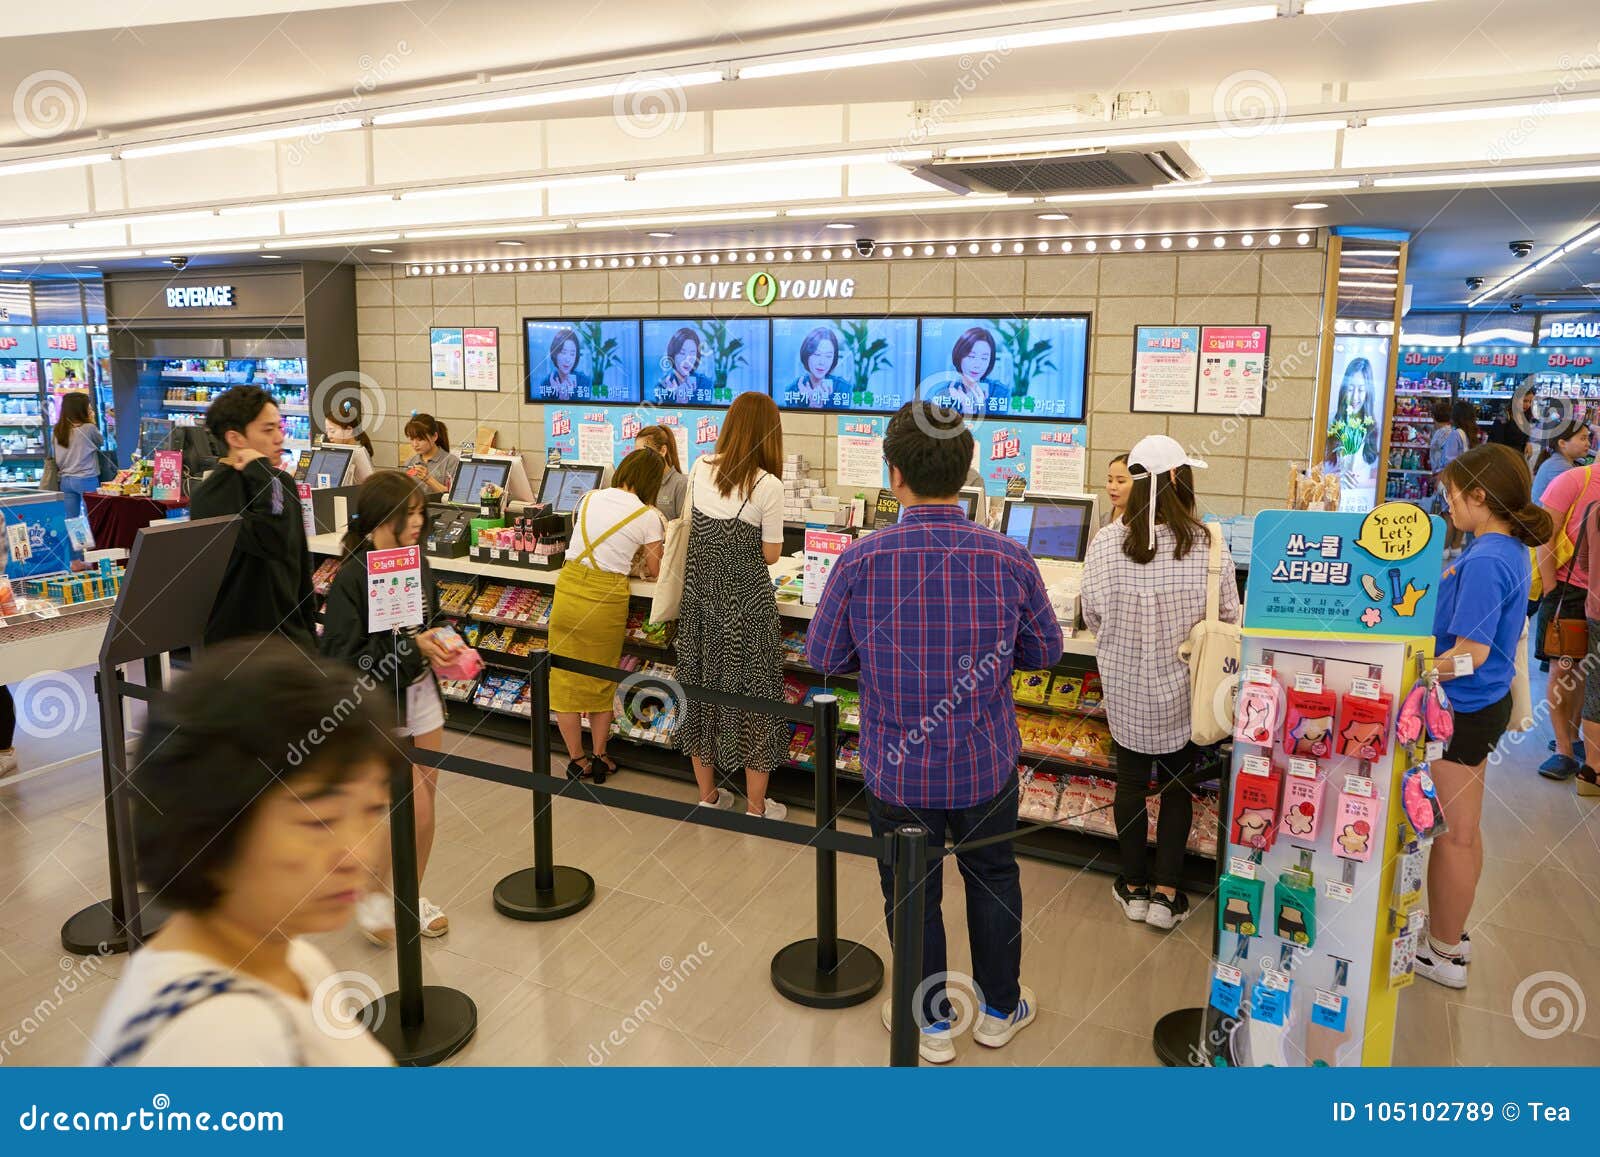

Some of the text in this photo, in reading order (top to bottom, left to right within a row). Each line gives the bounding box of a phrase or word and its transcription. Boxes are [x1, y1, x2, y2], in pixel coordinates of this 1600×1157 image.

[166, 285, 233, 308] BEVERAGE
[683, 281, 743, 300] OLIVE
[779, 278, 855, 298] YOUNG
[1161, 337, 1182, 350] 세일
[1209, 339, 1259, 349] 오늘의 특가3
[1493, 353, 1518, 368] 세일
[539, 385, 558, 397] 피부가
[576, 385, 590, 398] 종일
[653, 388, 676, 401] 피부가
[678, 388, 694, 401] 하루
[696, 388, 712, 401] 종일
[784, 391, 809, 404] 피부가
[812, 391, 829, 405] 하루
[832, 392, 850, 406] 종일
[933, 396, 961, 409] 피부가
[965, 396, 985, 410] 하루
[988, 397, 1008, 412] 종일
[551, 418, 571, 437] 세일
[621, 421, 642, 440] 세일
[696, 425, 719, 444] 세일
[855, 423, 873, 435] 세일
[1053, 431, 1073, 445] 세일
[990, 437, 1020, 461] 세일
[877, 498, 899, 507] 150%
[1373, 511, 1417, 526] So cool
[1379, 526, 1413, 540] Let's
[809, 540, 828, 550] 오늘의
[1286, 533, 1341, 559] 쏘~쿨
[1382, 540, 1411, 556] Try!
[372, 557, 415, 570] 오늘의 특가3
[1271, 559, 1351, 586] 스타일링
